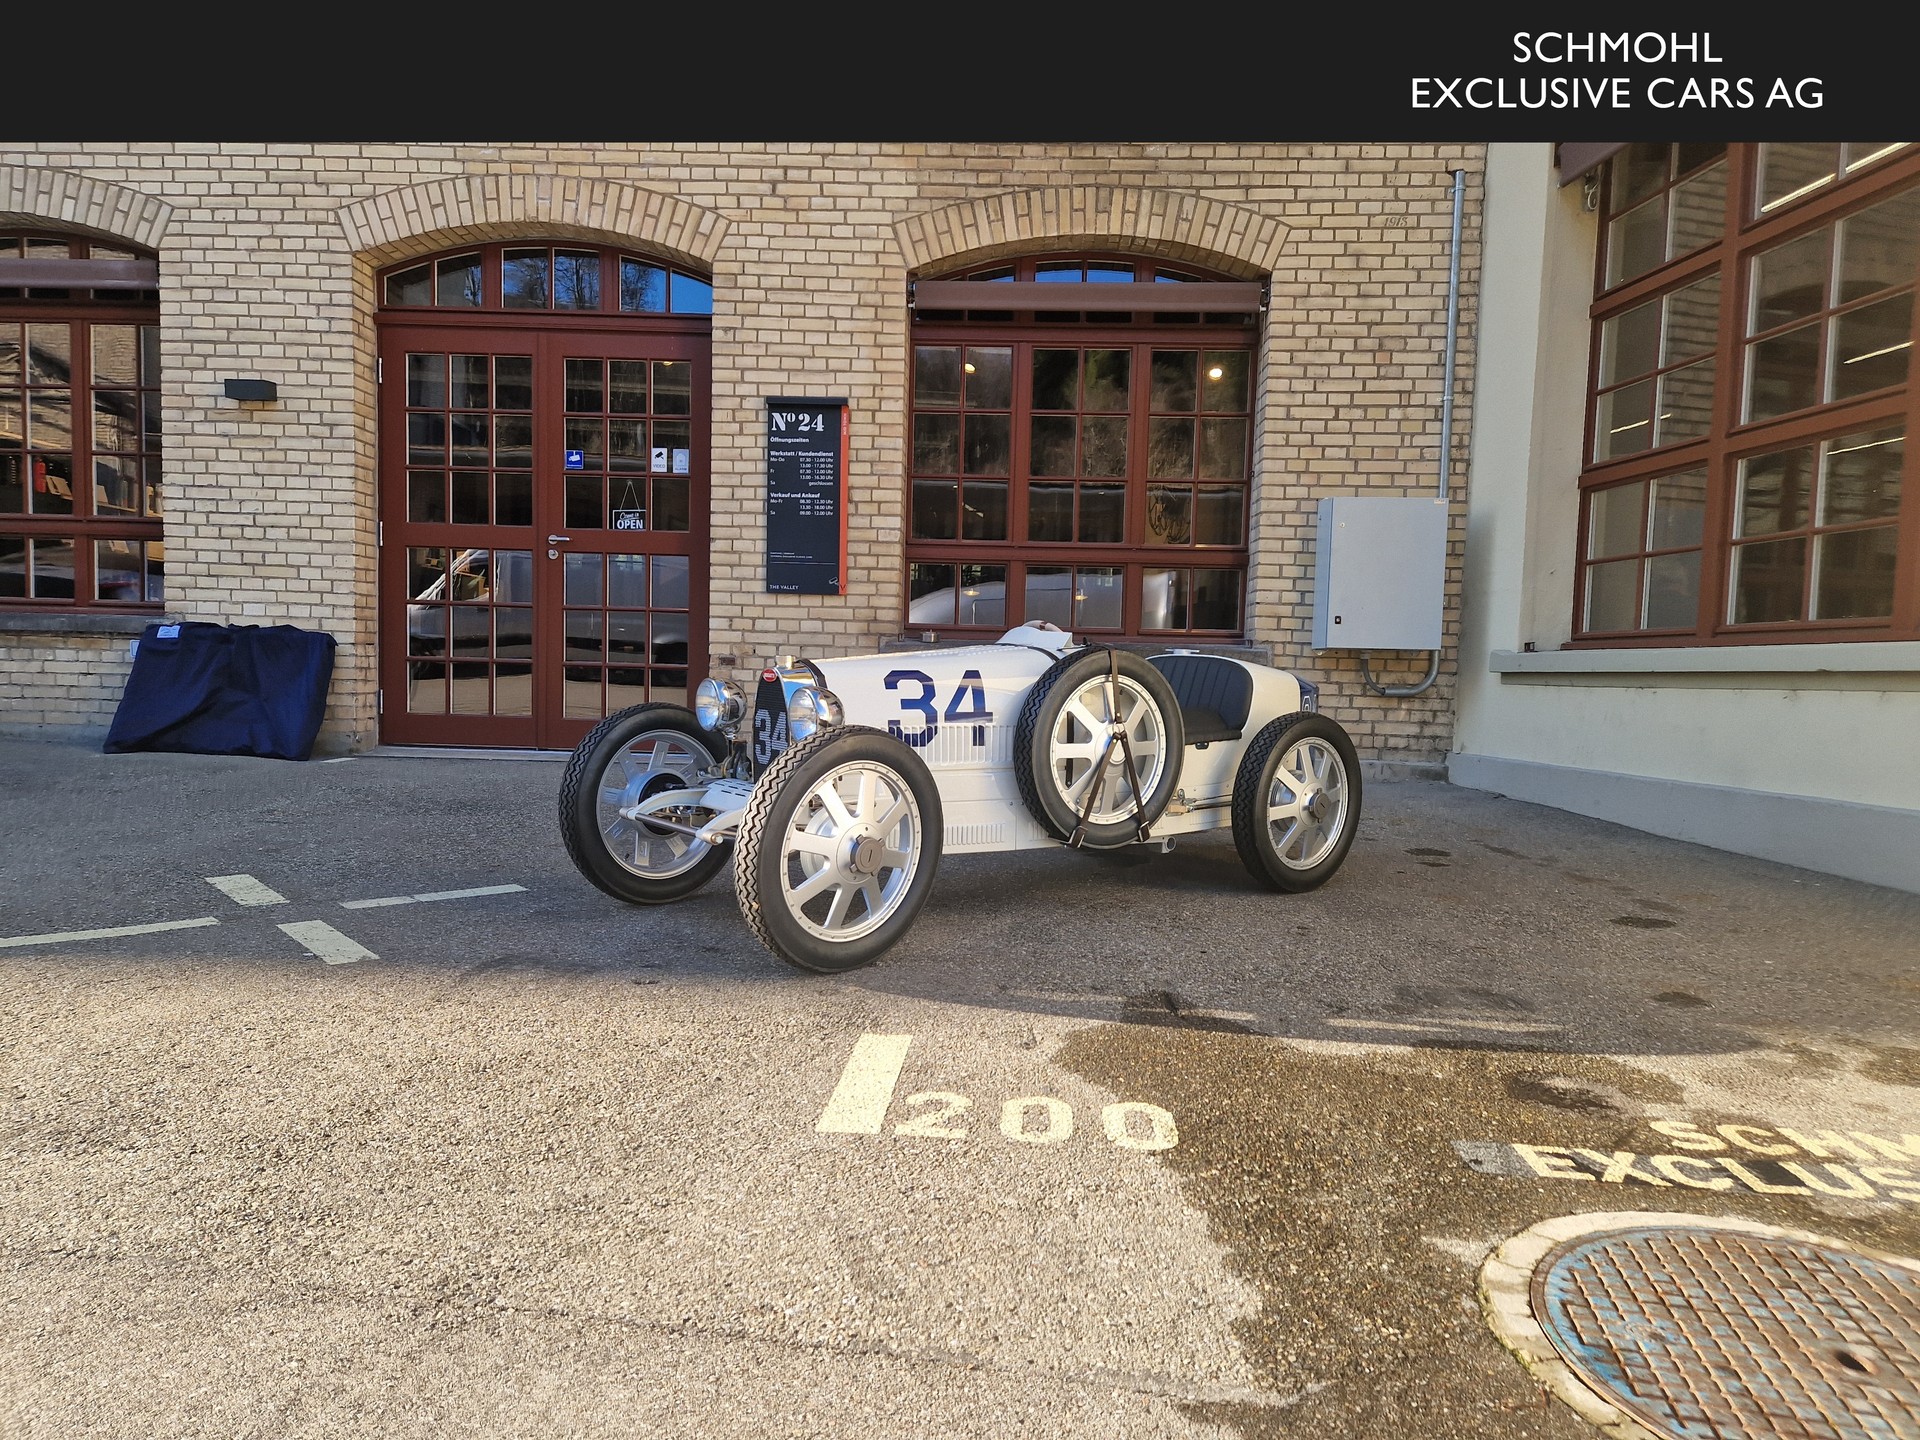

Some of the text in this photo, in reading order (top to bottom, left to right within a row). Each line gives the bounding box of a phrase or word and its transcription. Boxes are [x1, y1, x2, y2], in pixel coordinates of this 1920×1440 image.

[798, 413, 825, 432] 24
[617, 520, 643, 529] OPEN
[883, 669, 993, 747] 34
[755, 709, 788, 765] 34
[894, 1091, 1180, 1151] 200
